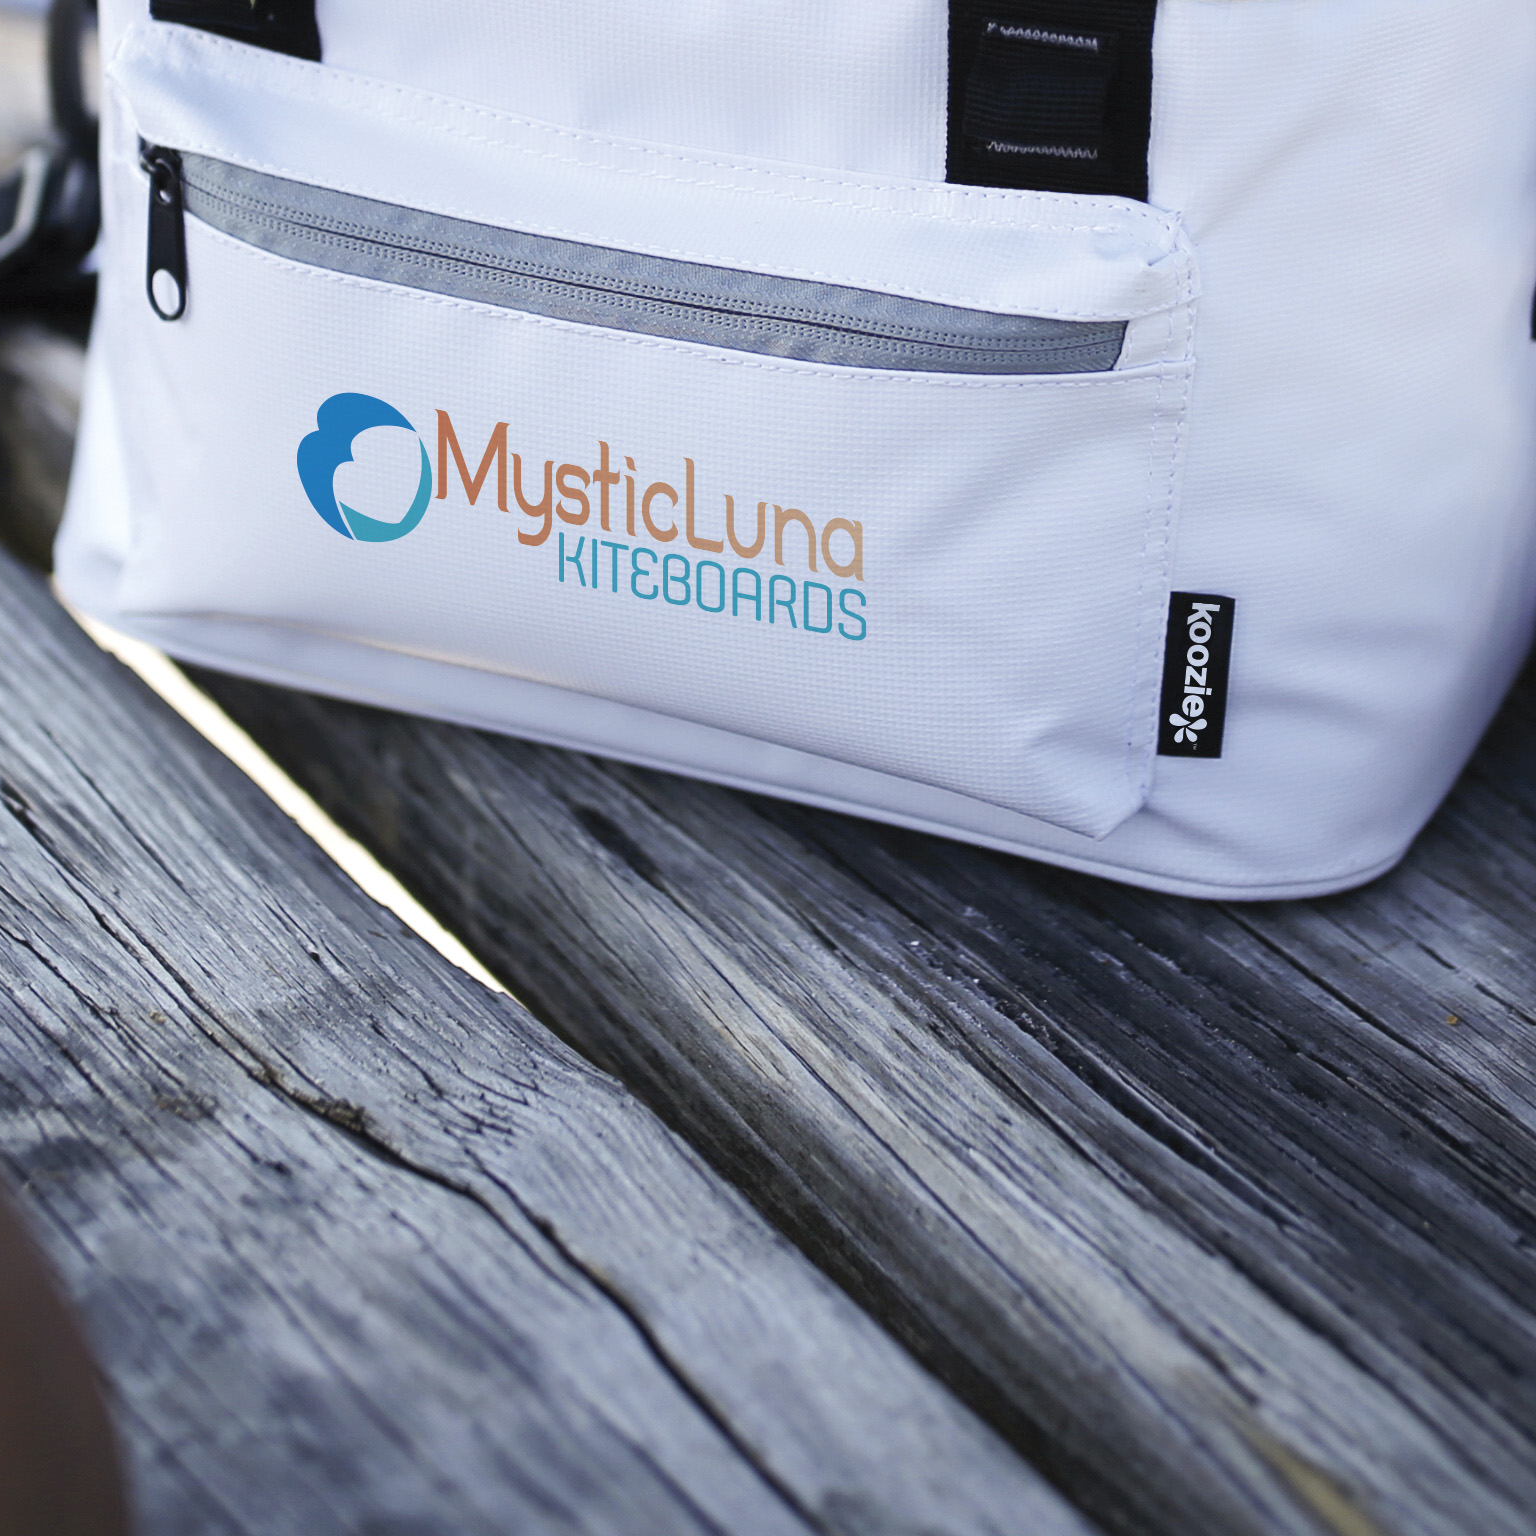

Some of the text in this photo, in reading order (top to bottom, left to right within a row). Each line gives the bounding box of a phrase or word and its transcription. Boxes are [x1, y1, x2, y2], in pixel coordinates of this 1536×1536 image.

[434, 409, 866, 582] MysticLuna
[558, 531, 867, 642] KITEBOARDS
[1181, 602, 1221, 718] koozie
